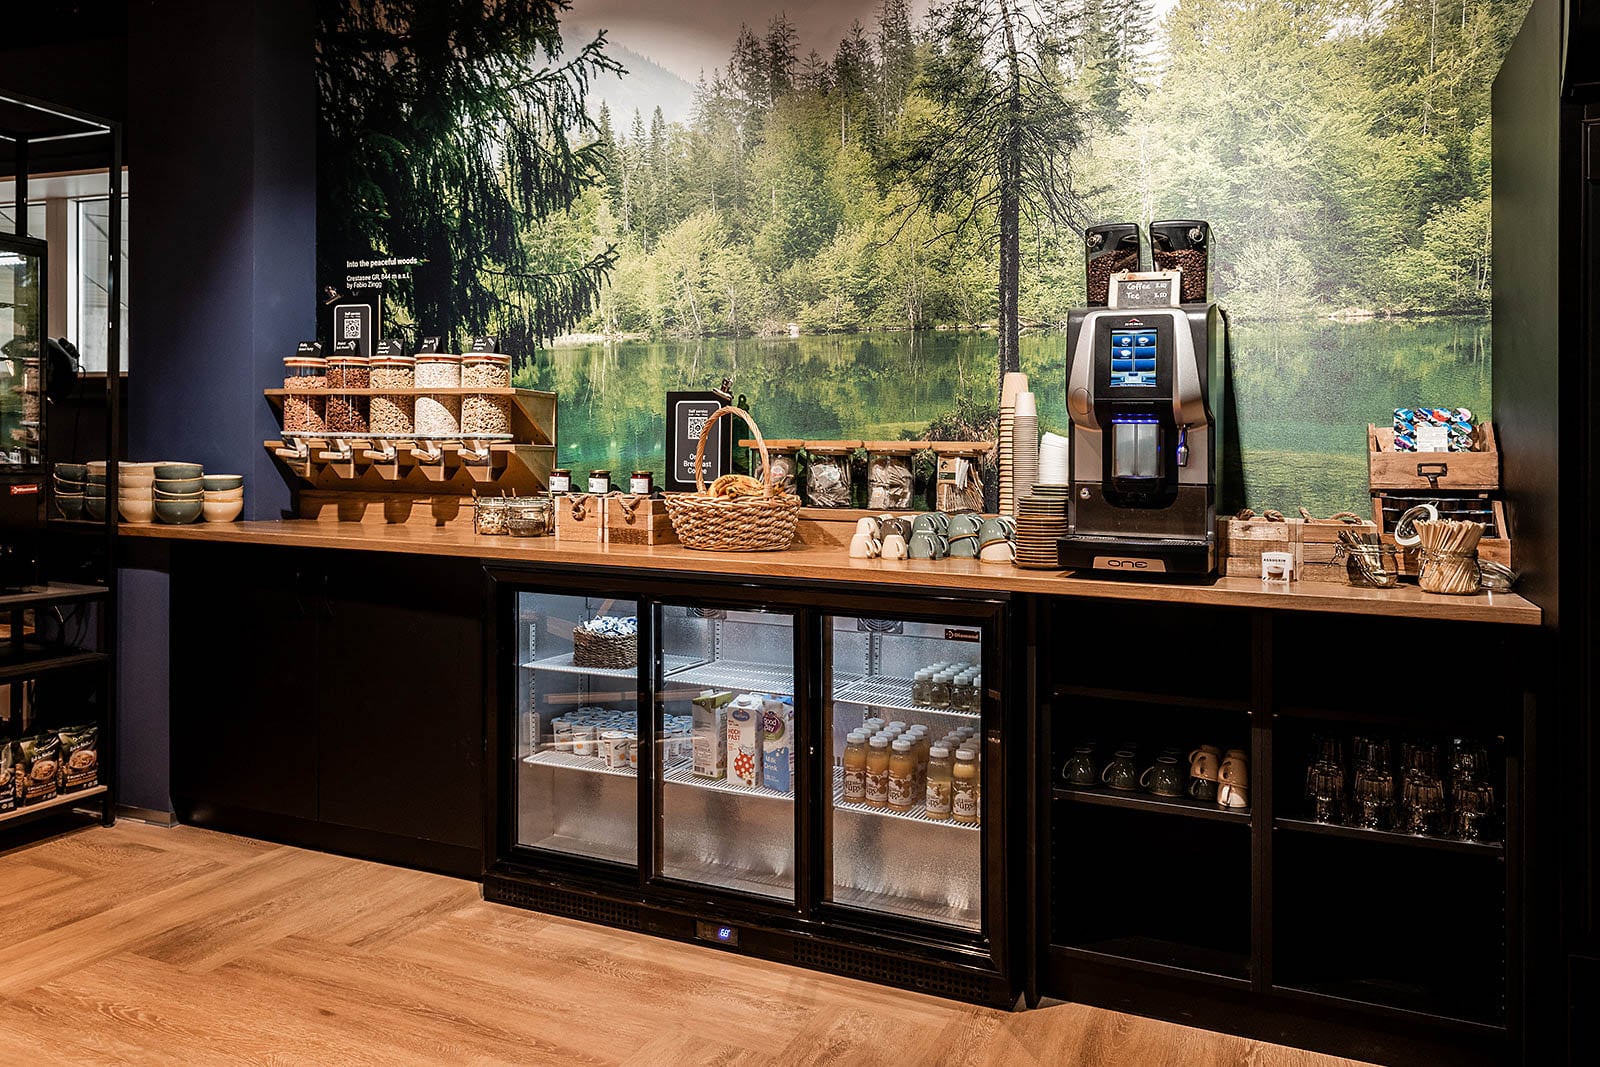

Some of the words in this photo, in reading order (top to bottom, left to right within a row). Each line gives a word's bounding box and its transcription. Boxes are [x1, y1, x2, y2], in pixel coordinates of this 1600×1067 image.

[346, 260, 358, 268] Into
[359, 259, 370, 267] the
[370, 257, 397, 268] peaceful
[397, 256, 418, 265] woods
[346, 282, 353, 290] by
[368, 281, 382, 289] Zingg
